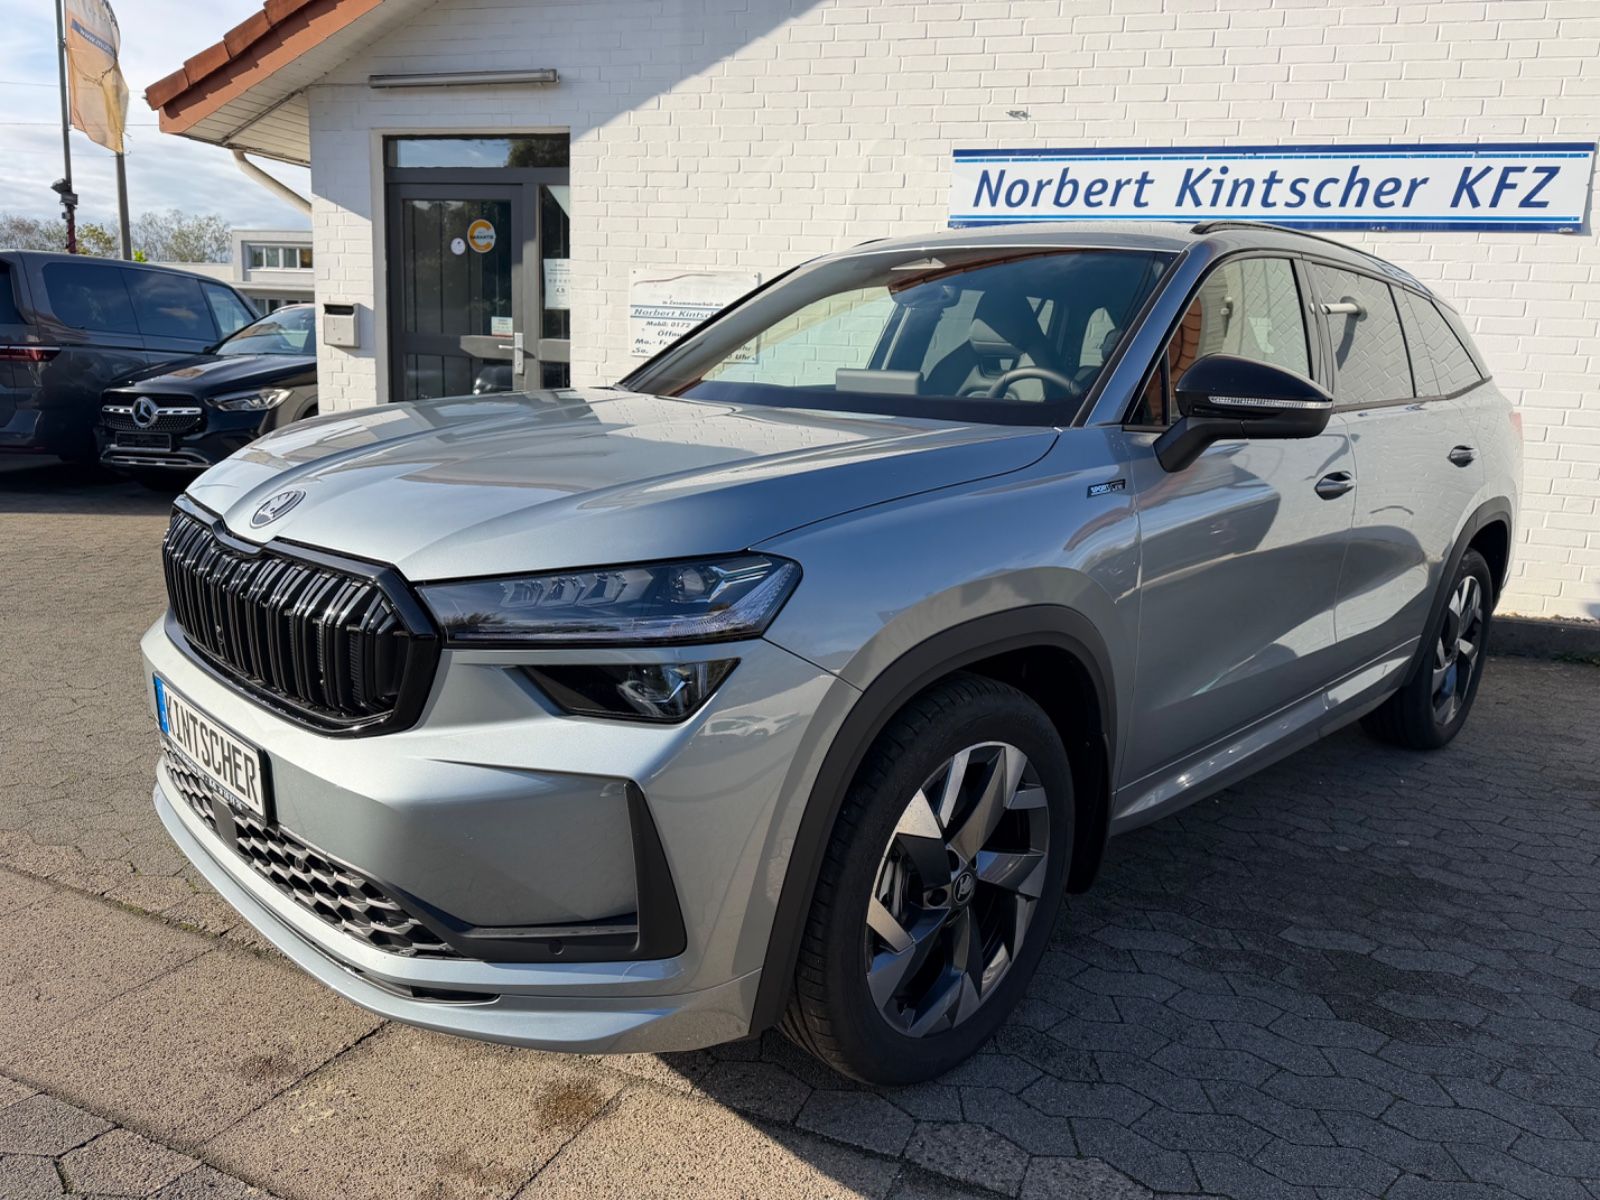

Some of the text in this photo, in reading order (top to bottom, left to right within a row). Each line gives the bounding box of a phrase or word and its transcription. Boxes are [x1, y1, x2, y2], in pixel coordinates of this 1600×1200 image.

[973, 165, 1561, 209] Norbert Kintscher KFZ
[634, 308, 675, 316] Norbert
[165, 691, 259, 805] KINTSCHER
